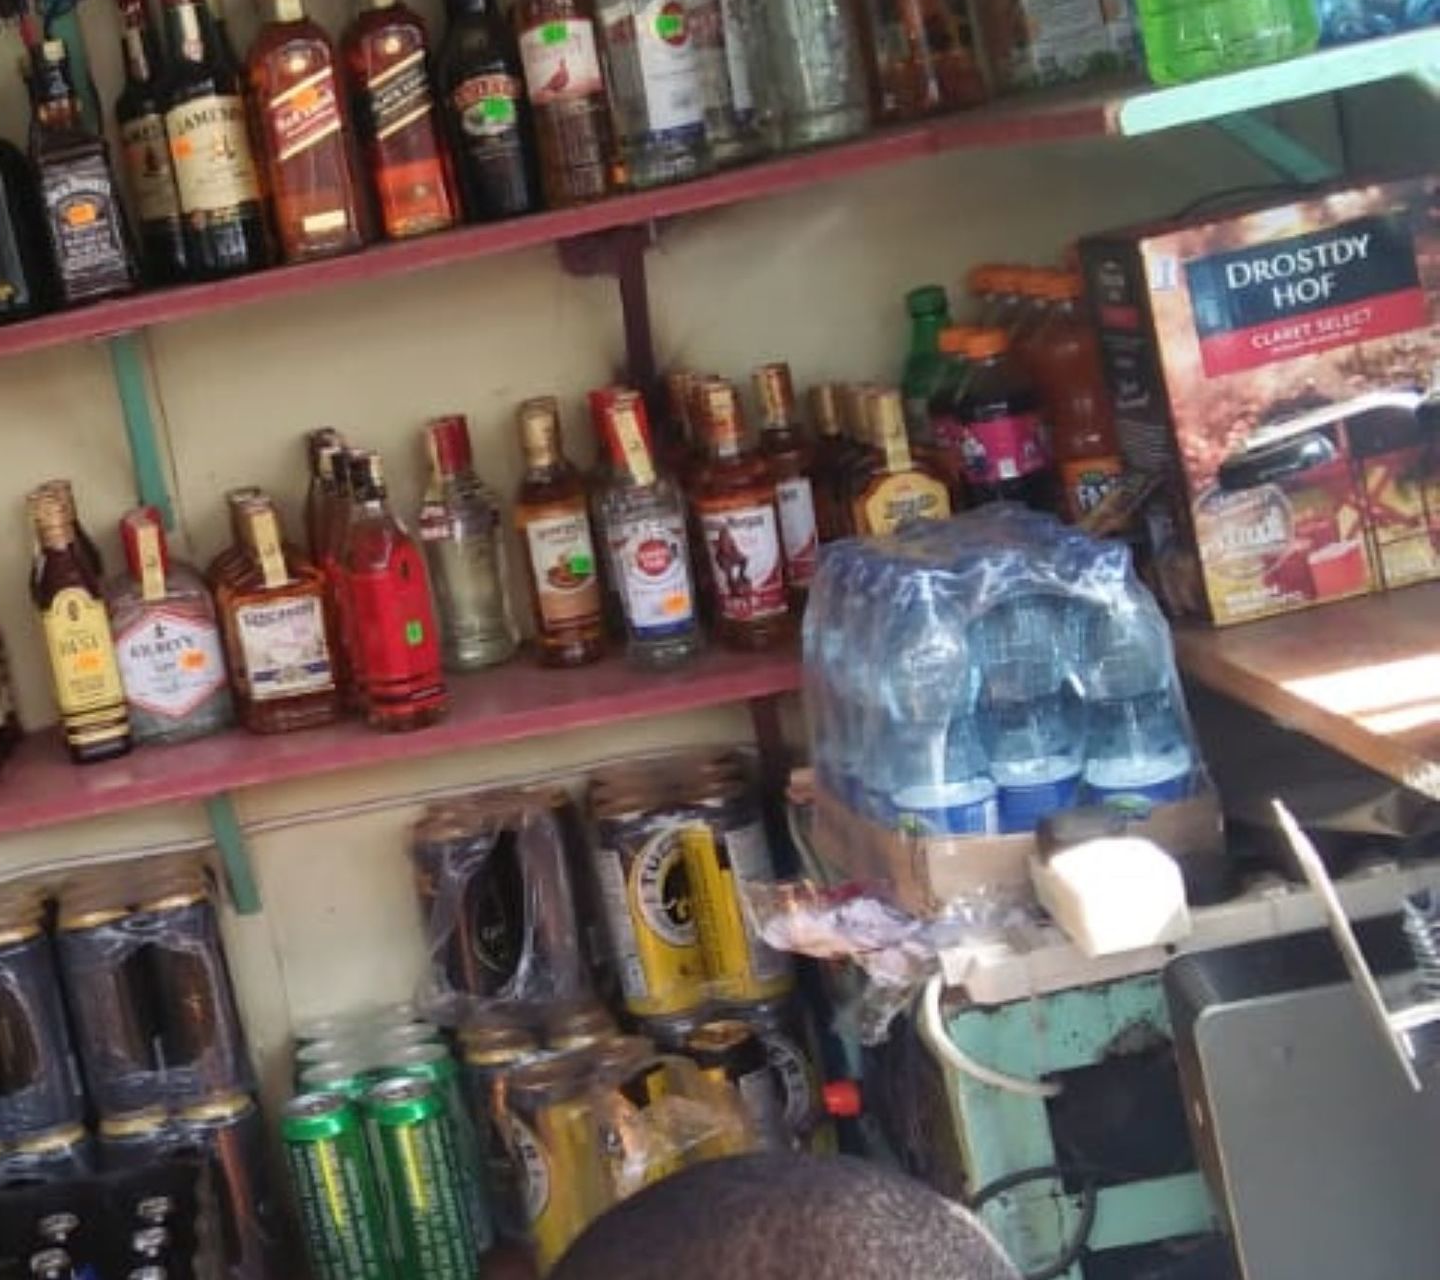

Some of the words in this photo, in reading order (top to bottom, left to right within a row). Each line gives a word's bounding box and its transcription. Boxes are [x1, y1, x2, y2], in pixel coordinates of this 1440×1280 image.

[1224, 232, 1372, 289] DROSTDY
[1271, 271, 1338, 310] HOF
[1251, 322, 1312, 349] CLARET
[1315, 307, 1372, 334] SELECT
